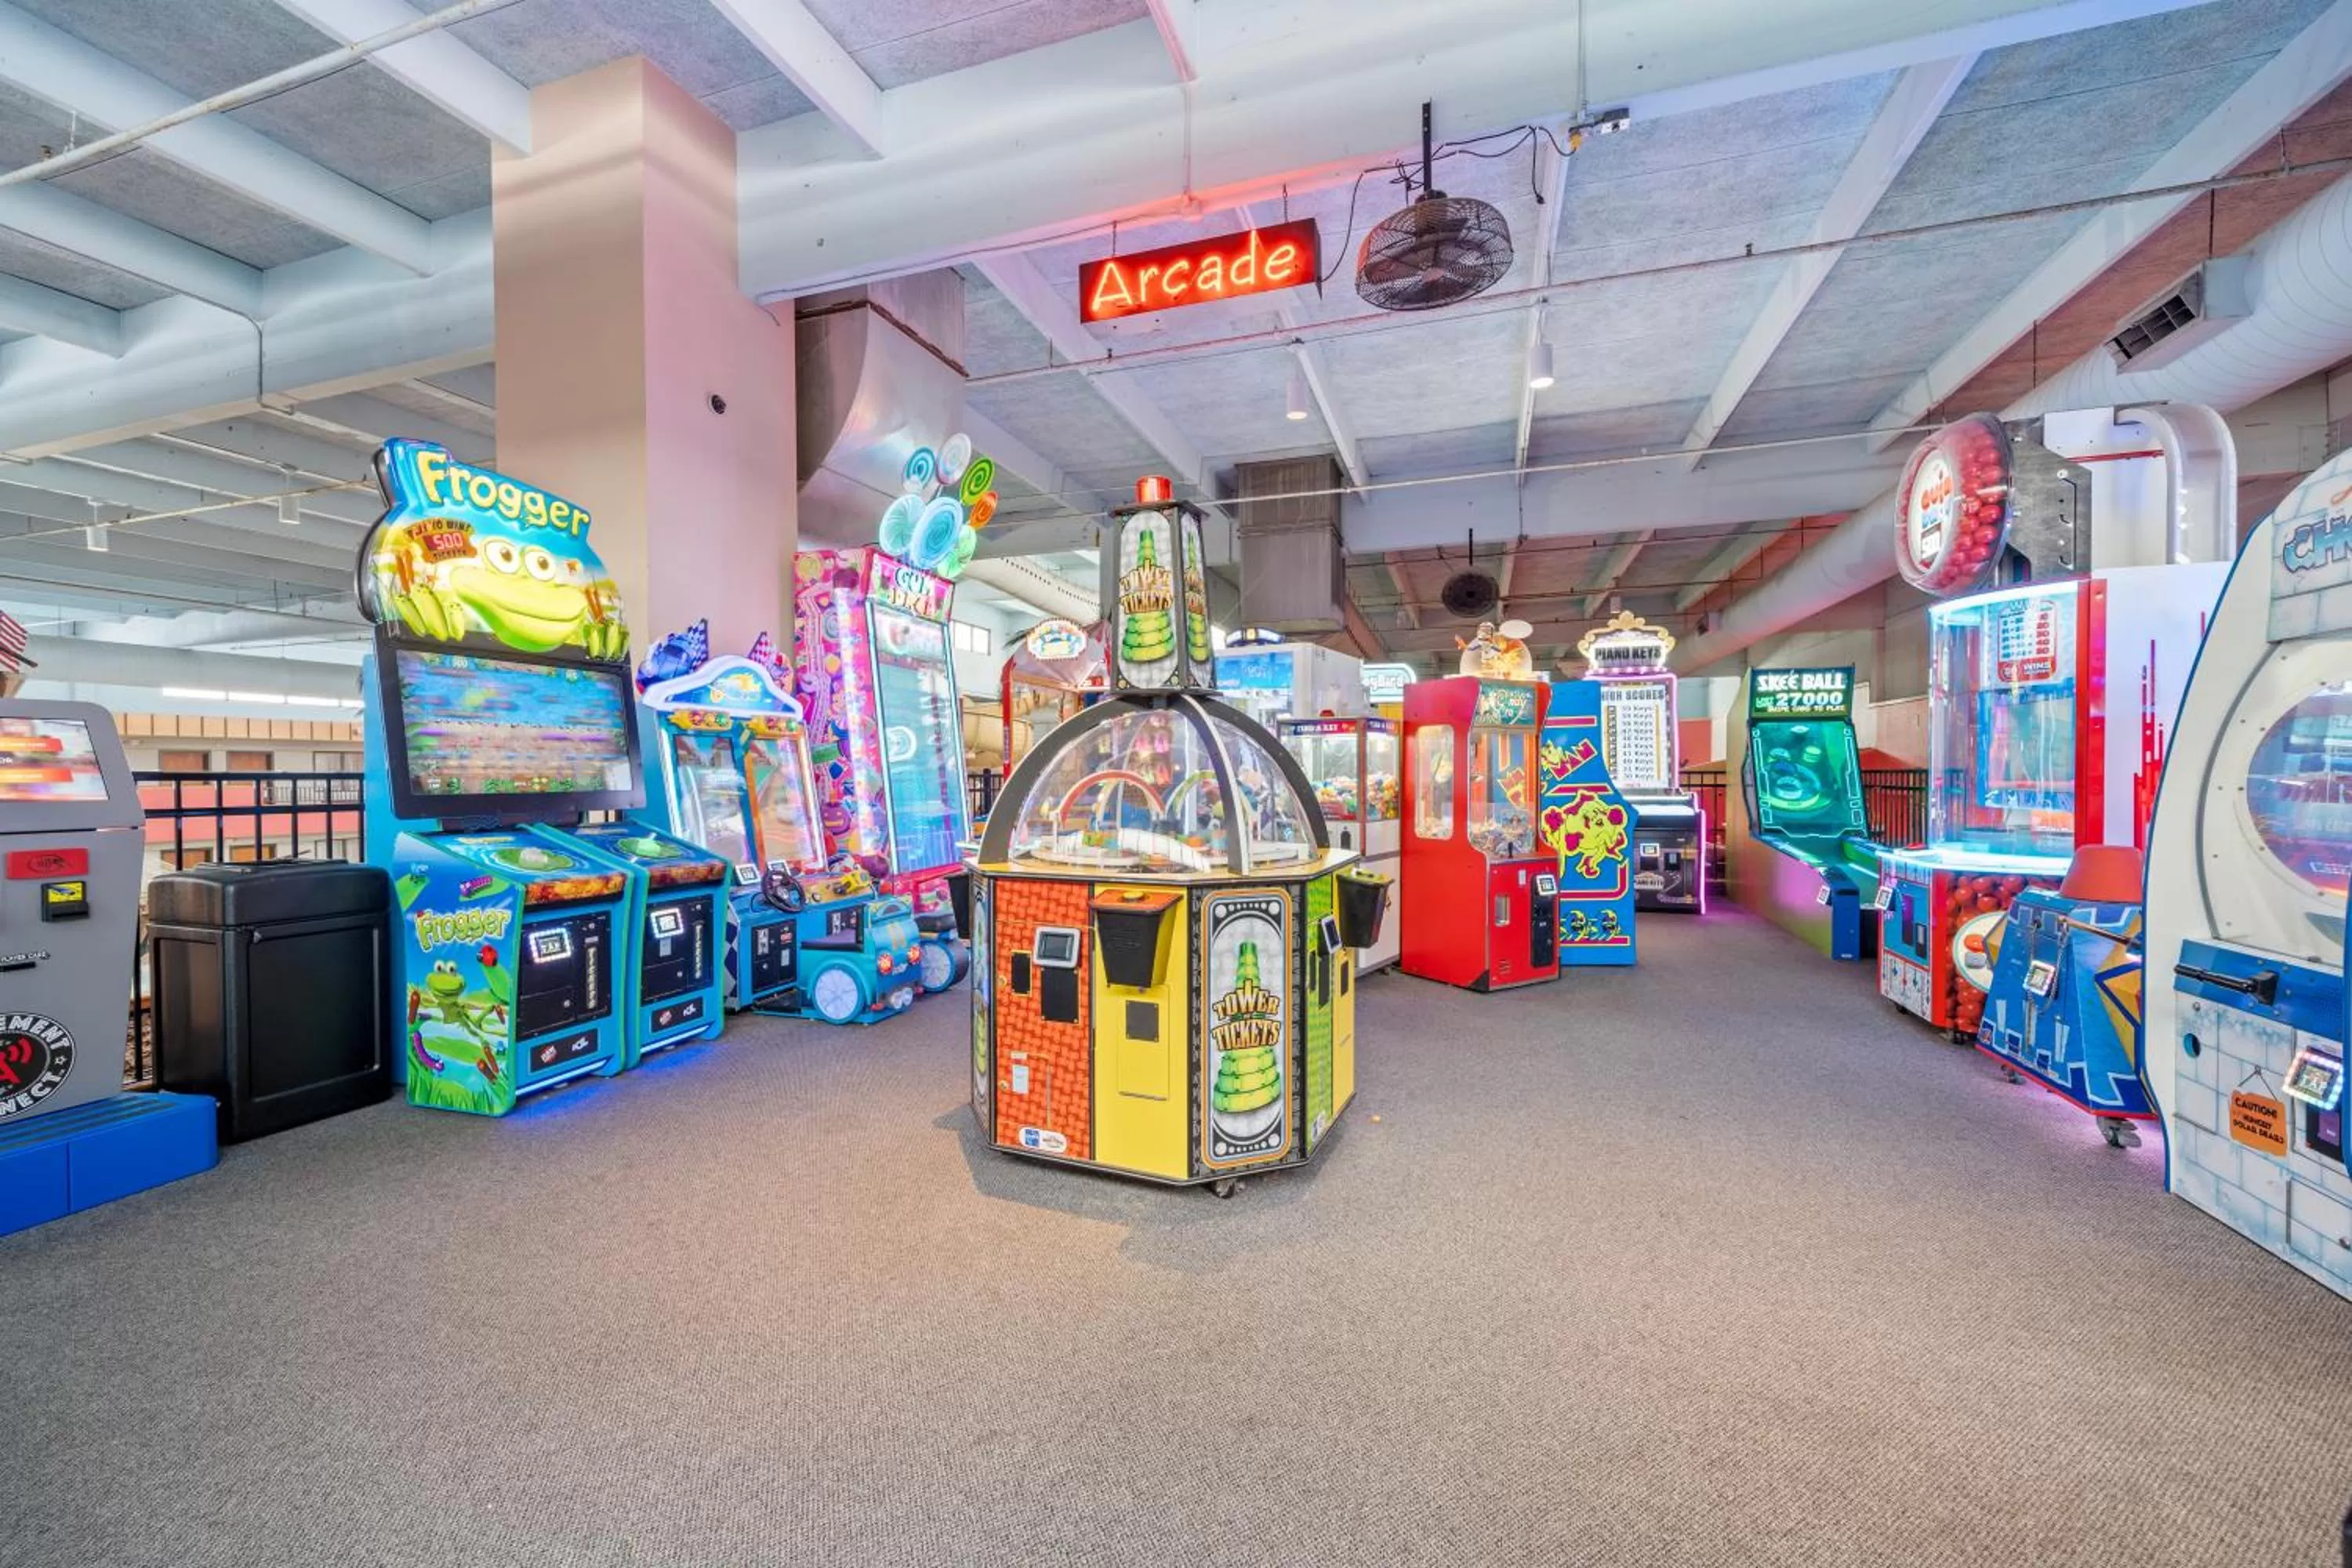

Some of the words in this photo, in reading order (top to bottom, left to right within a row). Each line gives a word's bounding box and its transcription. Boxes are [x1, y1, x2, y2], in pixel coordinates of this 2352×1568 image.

[1091, 228, 1295, 311] Arcade
[416, 450, 590, 536] Frogger
[433, 532, 463, 550] 500
[1120, 590, 1173, 615] TICKETS
[1595, 647, 1629, 661] PIANO
[1632, 646, 1661, 659] KEYS
[1802, 672, 1846, 691] BALL
[1625, 690, 1664, 700] SCORES
[1776, 691, 1843, 706] 27000
[415, 909, 512, 953] Frogger
[1213, 978, 1280, 1020] TOWER
[1211, 1019, 1281, 1051] TICKETS
